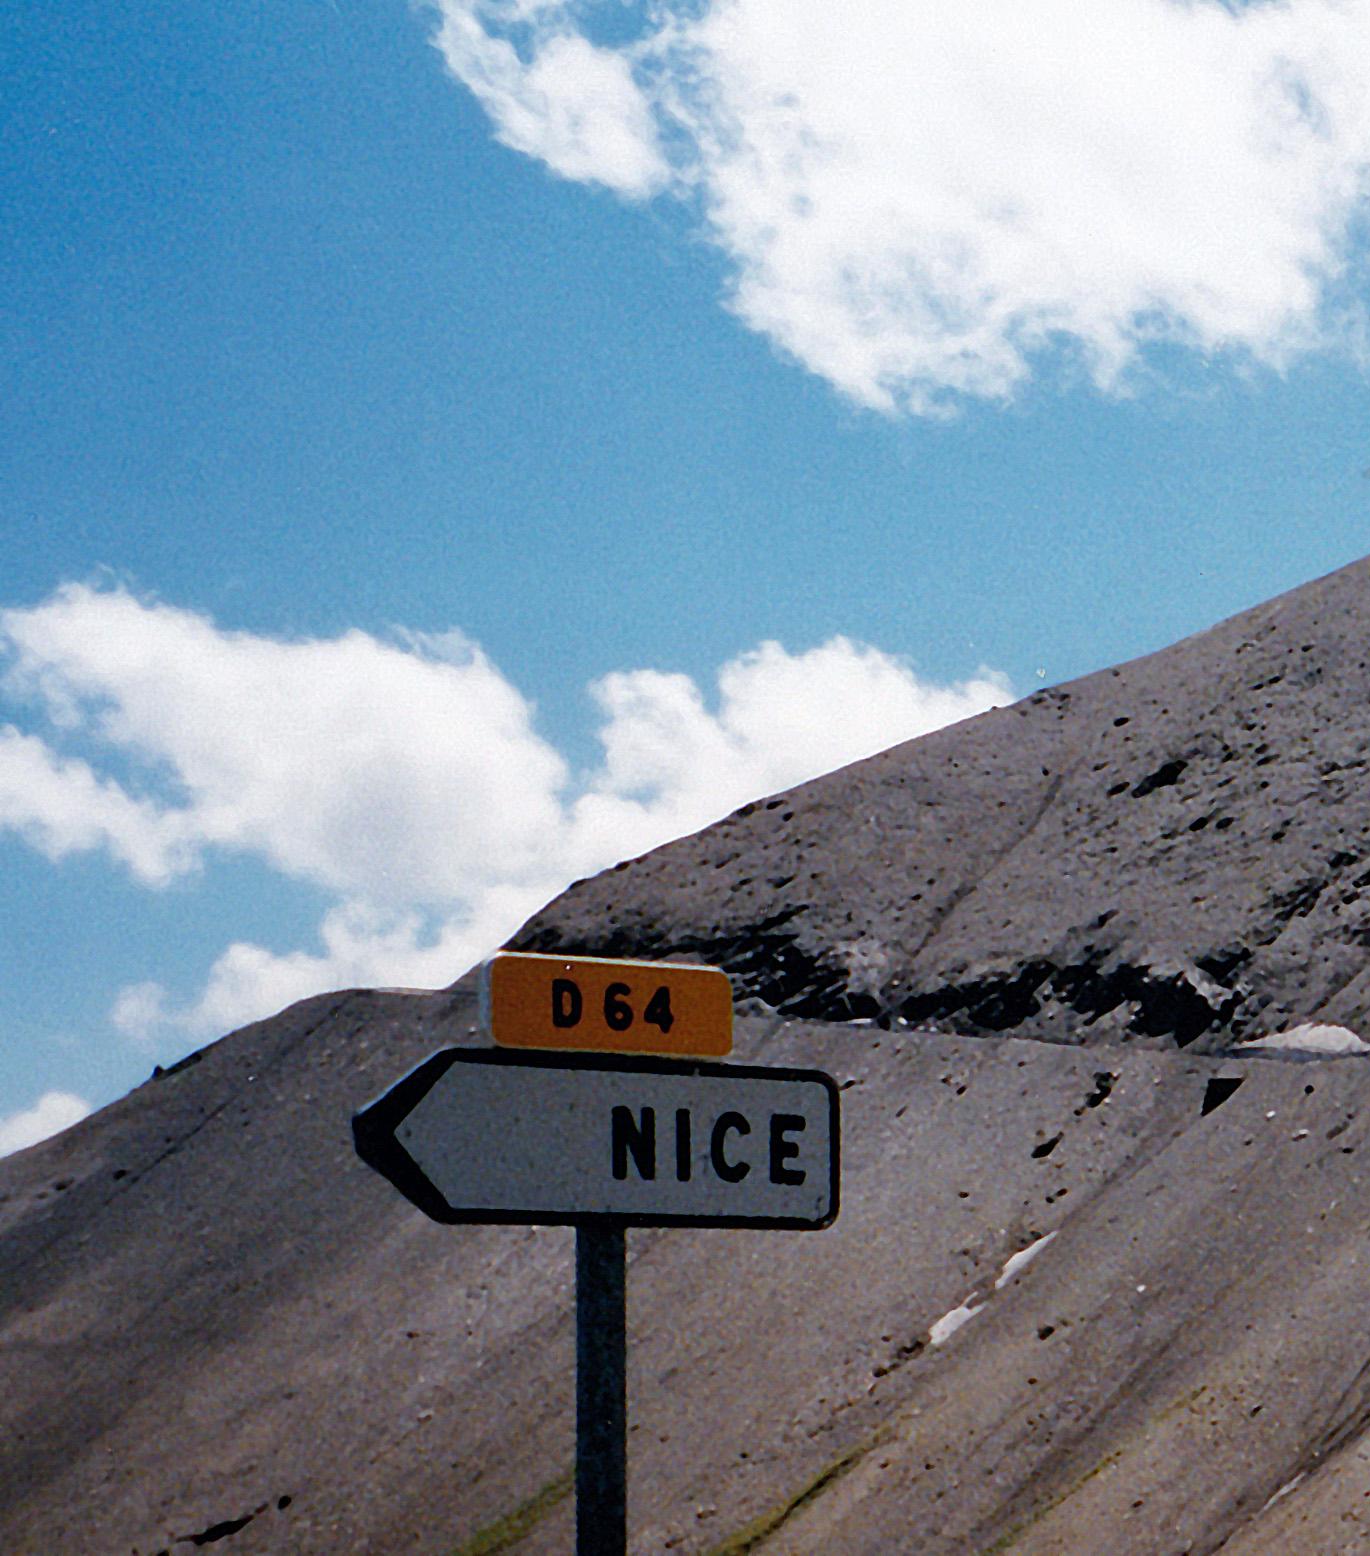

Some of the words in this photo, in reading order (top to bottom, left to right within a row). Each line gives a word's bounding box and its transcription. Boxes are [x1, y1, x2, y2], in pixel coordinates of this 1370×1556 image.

[552, 978, 583, 1028] D
[603, 982, 674, 1033] 64
[611, 1105, 807, 1186] NICE
